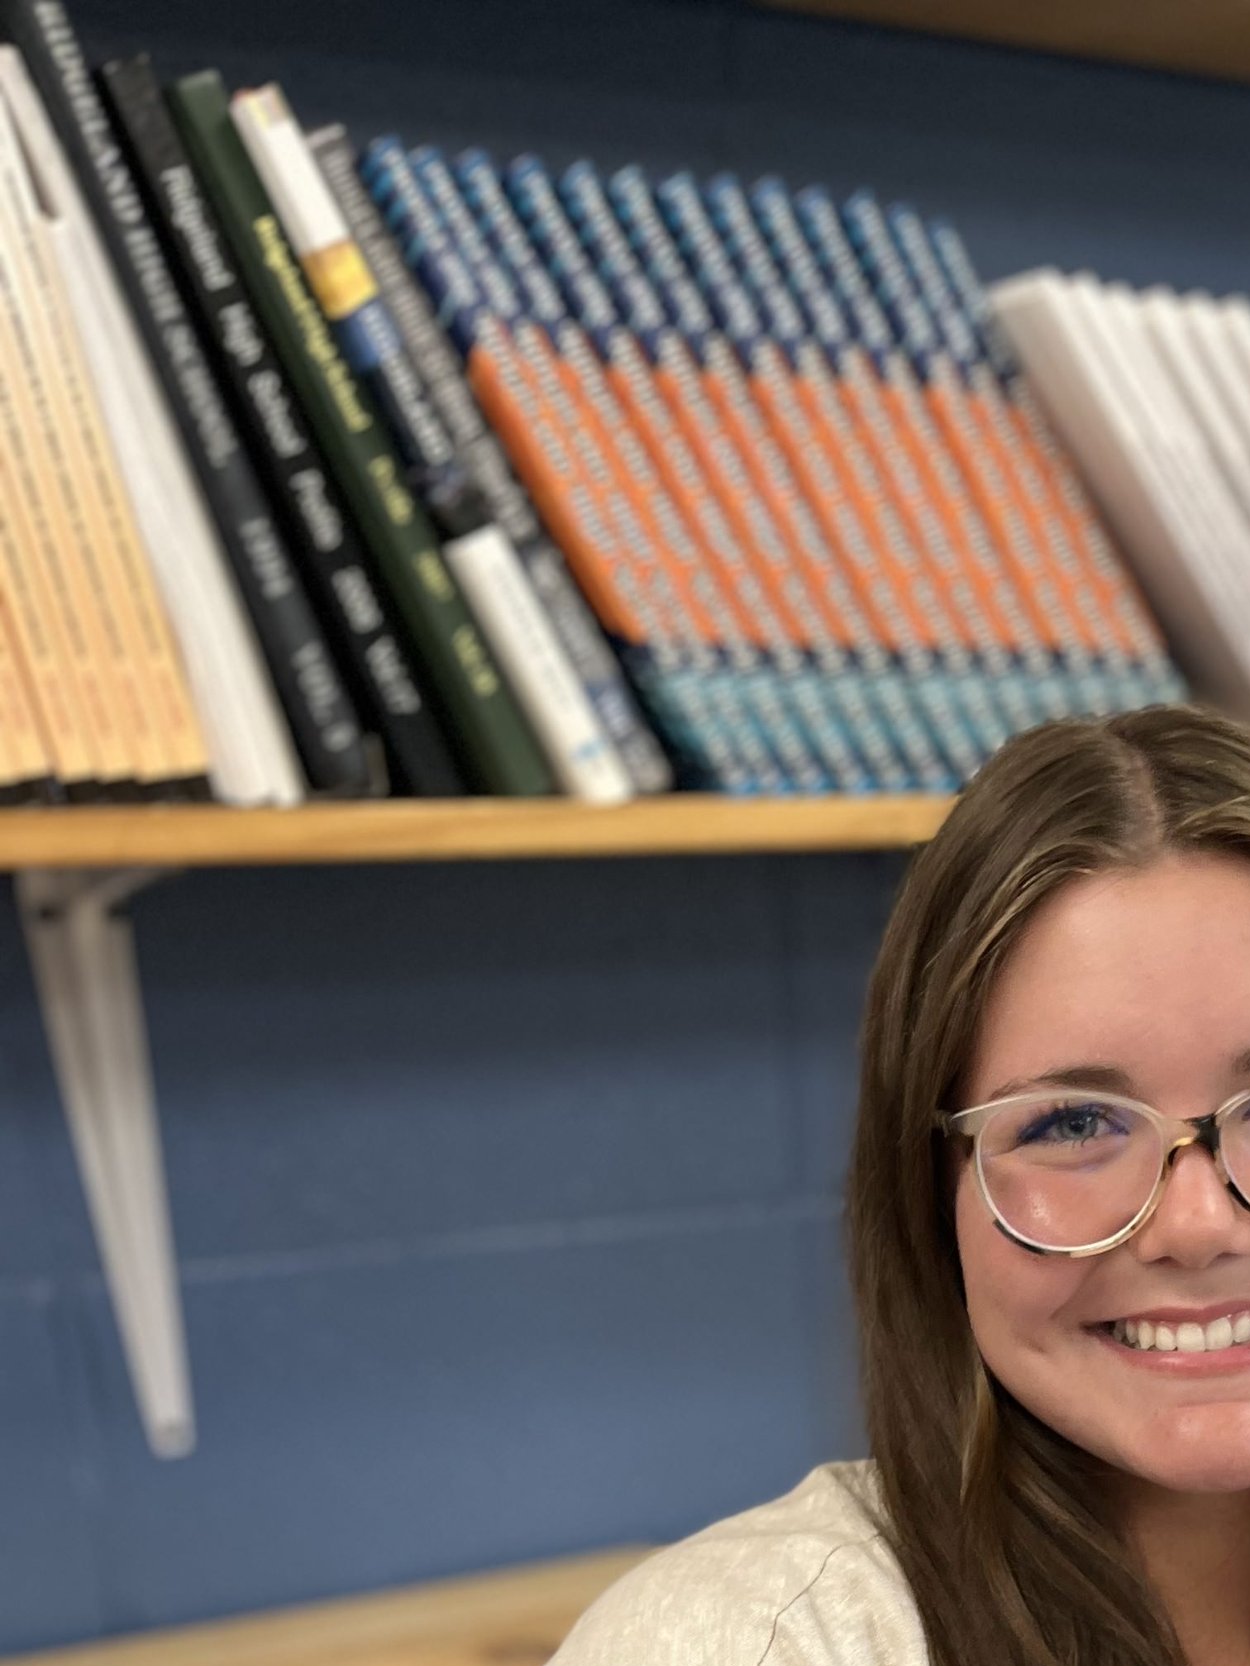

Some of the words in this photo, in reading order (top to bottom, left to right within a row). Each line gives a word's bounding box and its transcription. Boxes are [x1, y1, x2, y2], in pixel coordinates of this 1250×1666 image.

[123, 227, 181, 324] HIGH
[162, 323, 235, 467] SCHOOL
[160, 166, 233, 290] Ridgeland
[220, 303, 262, 366] High
[247, 371, 304, 457] School
[255, 217, 312, 312] Ridgeland
[320, 359, 369, 431] School
